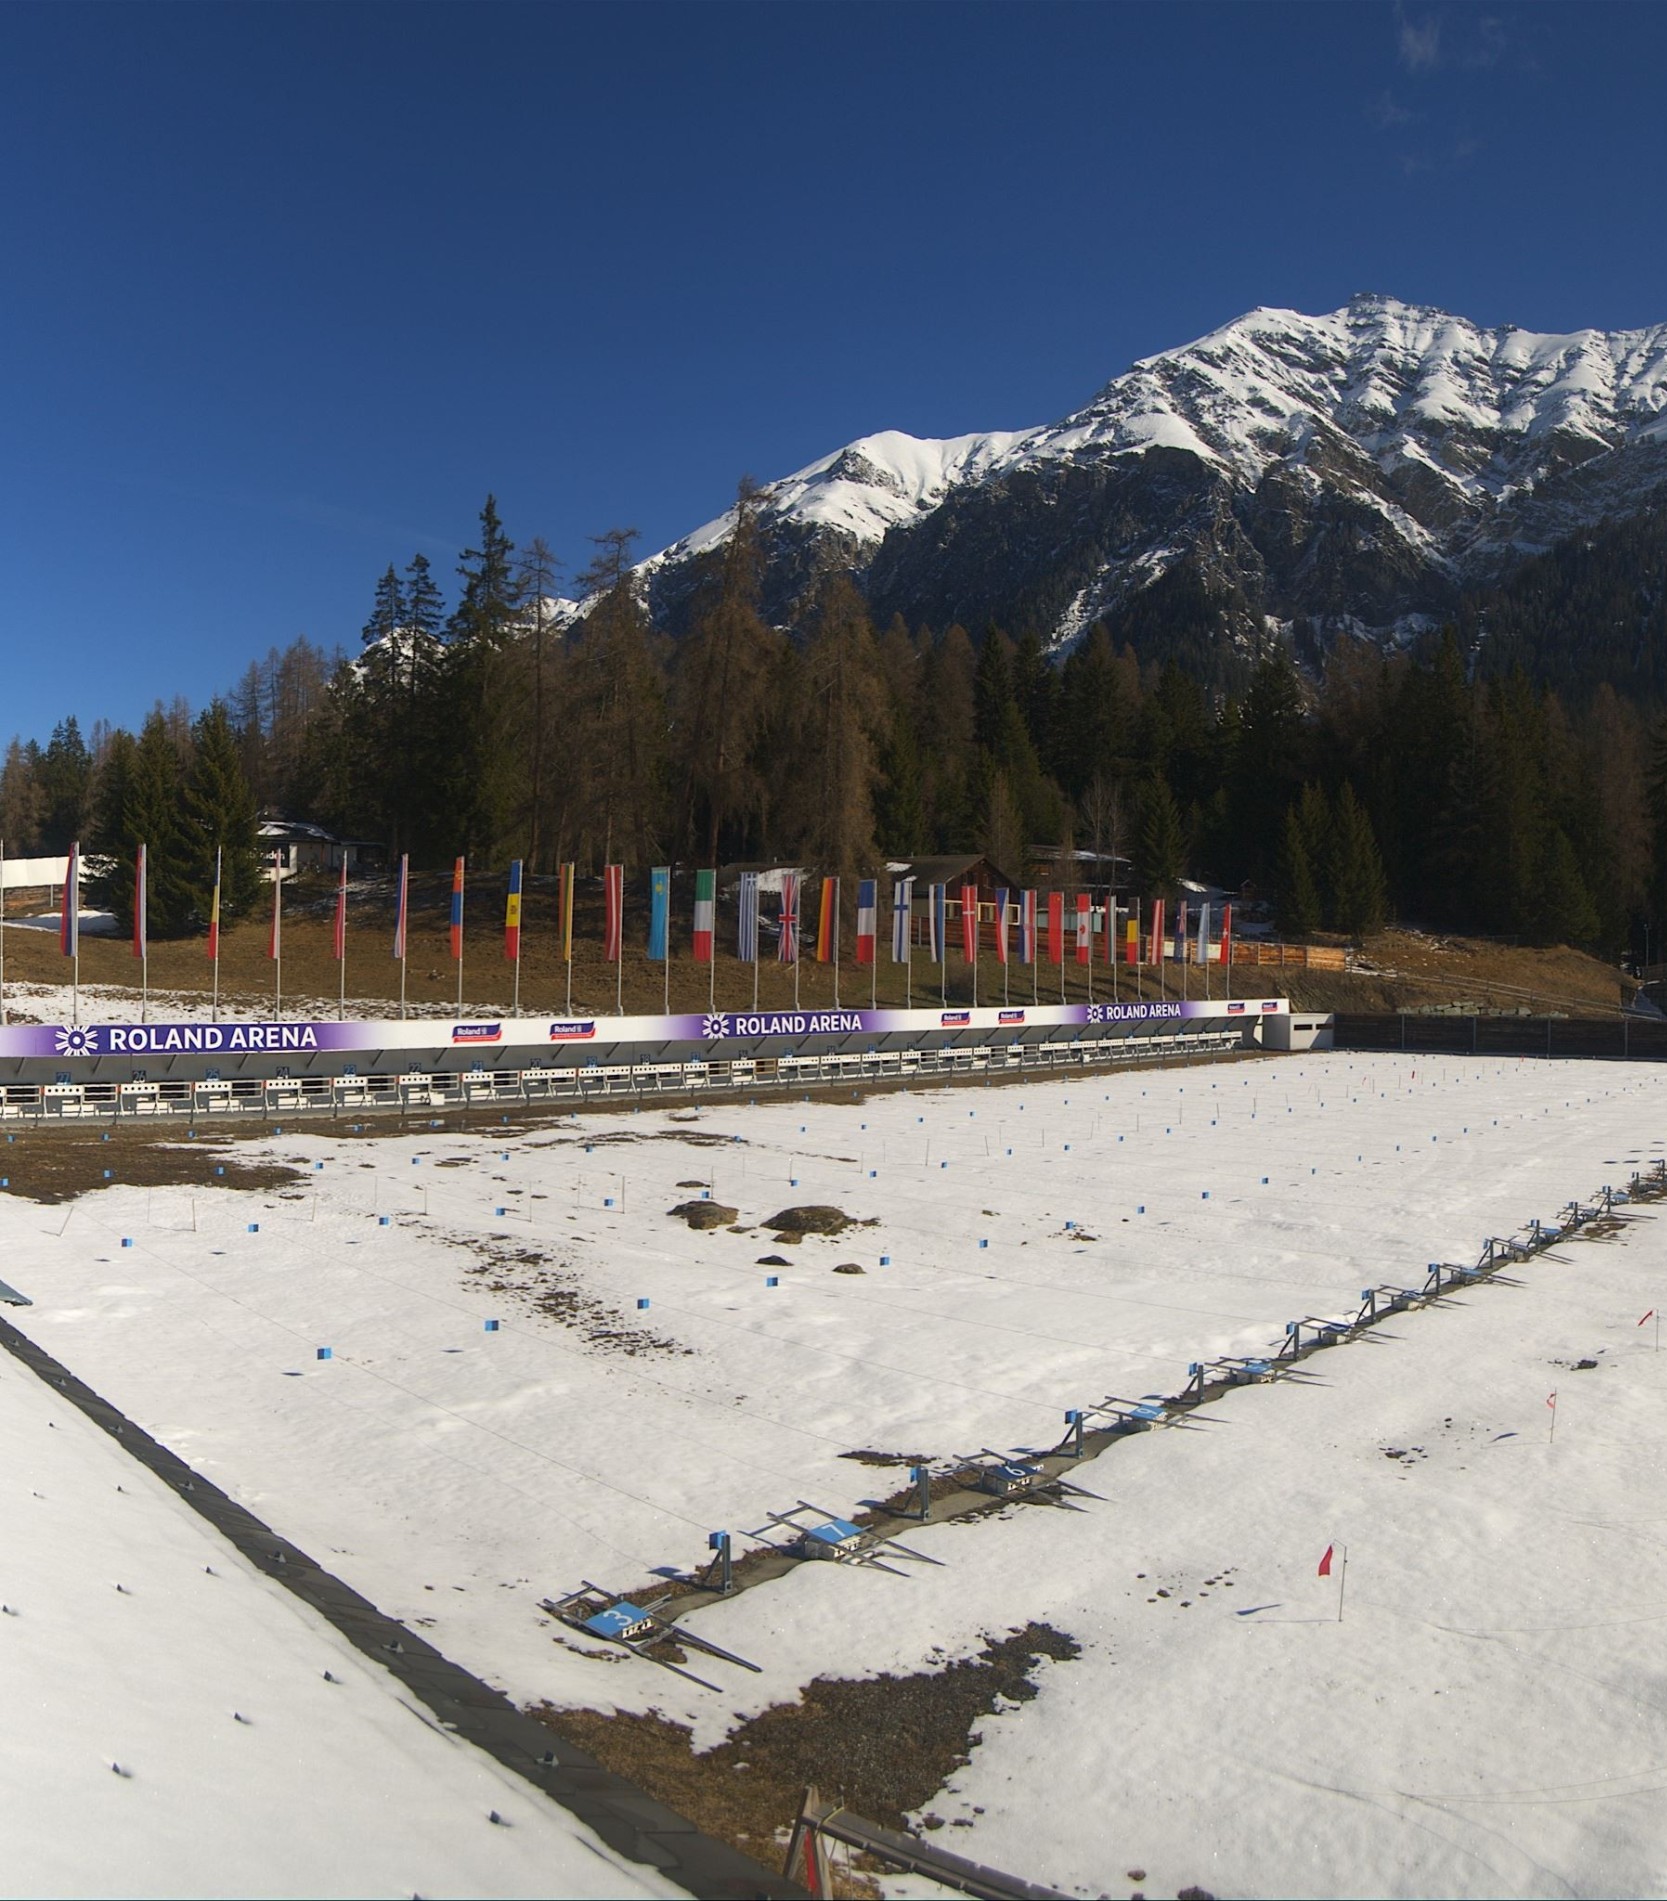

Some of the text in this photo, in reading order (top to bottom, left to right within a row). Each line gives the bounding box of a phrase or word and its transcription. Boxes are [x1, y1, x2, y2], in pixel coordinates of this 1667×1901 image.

[1106, 1004, 1181, 1020] ROLAND ARENA
[457, 1027, 481, 1035] Roland
[554, 1025, 576, 1033] Roland
[736, 1015, 862, 1035] ROLAND ARENA
[110, 1026, 318, 1050] ROLAND ARENA
[821, 1523, 846, 1538] 7
[603, 1609, 634, 1627] 3
